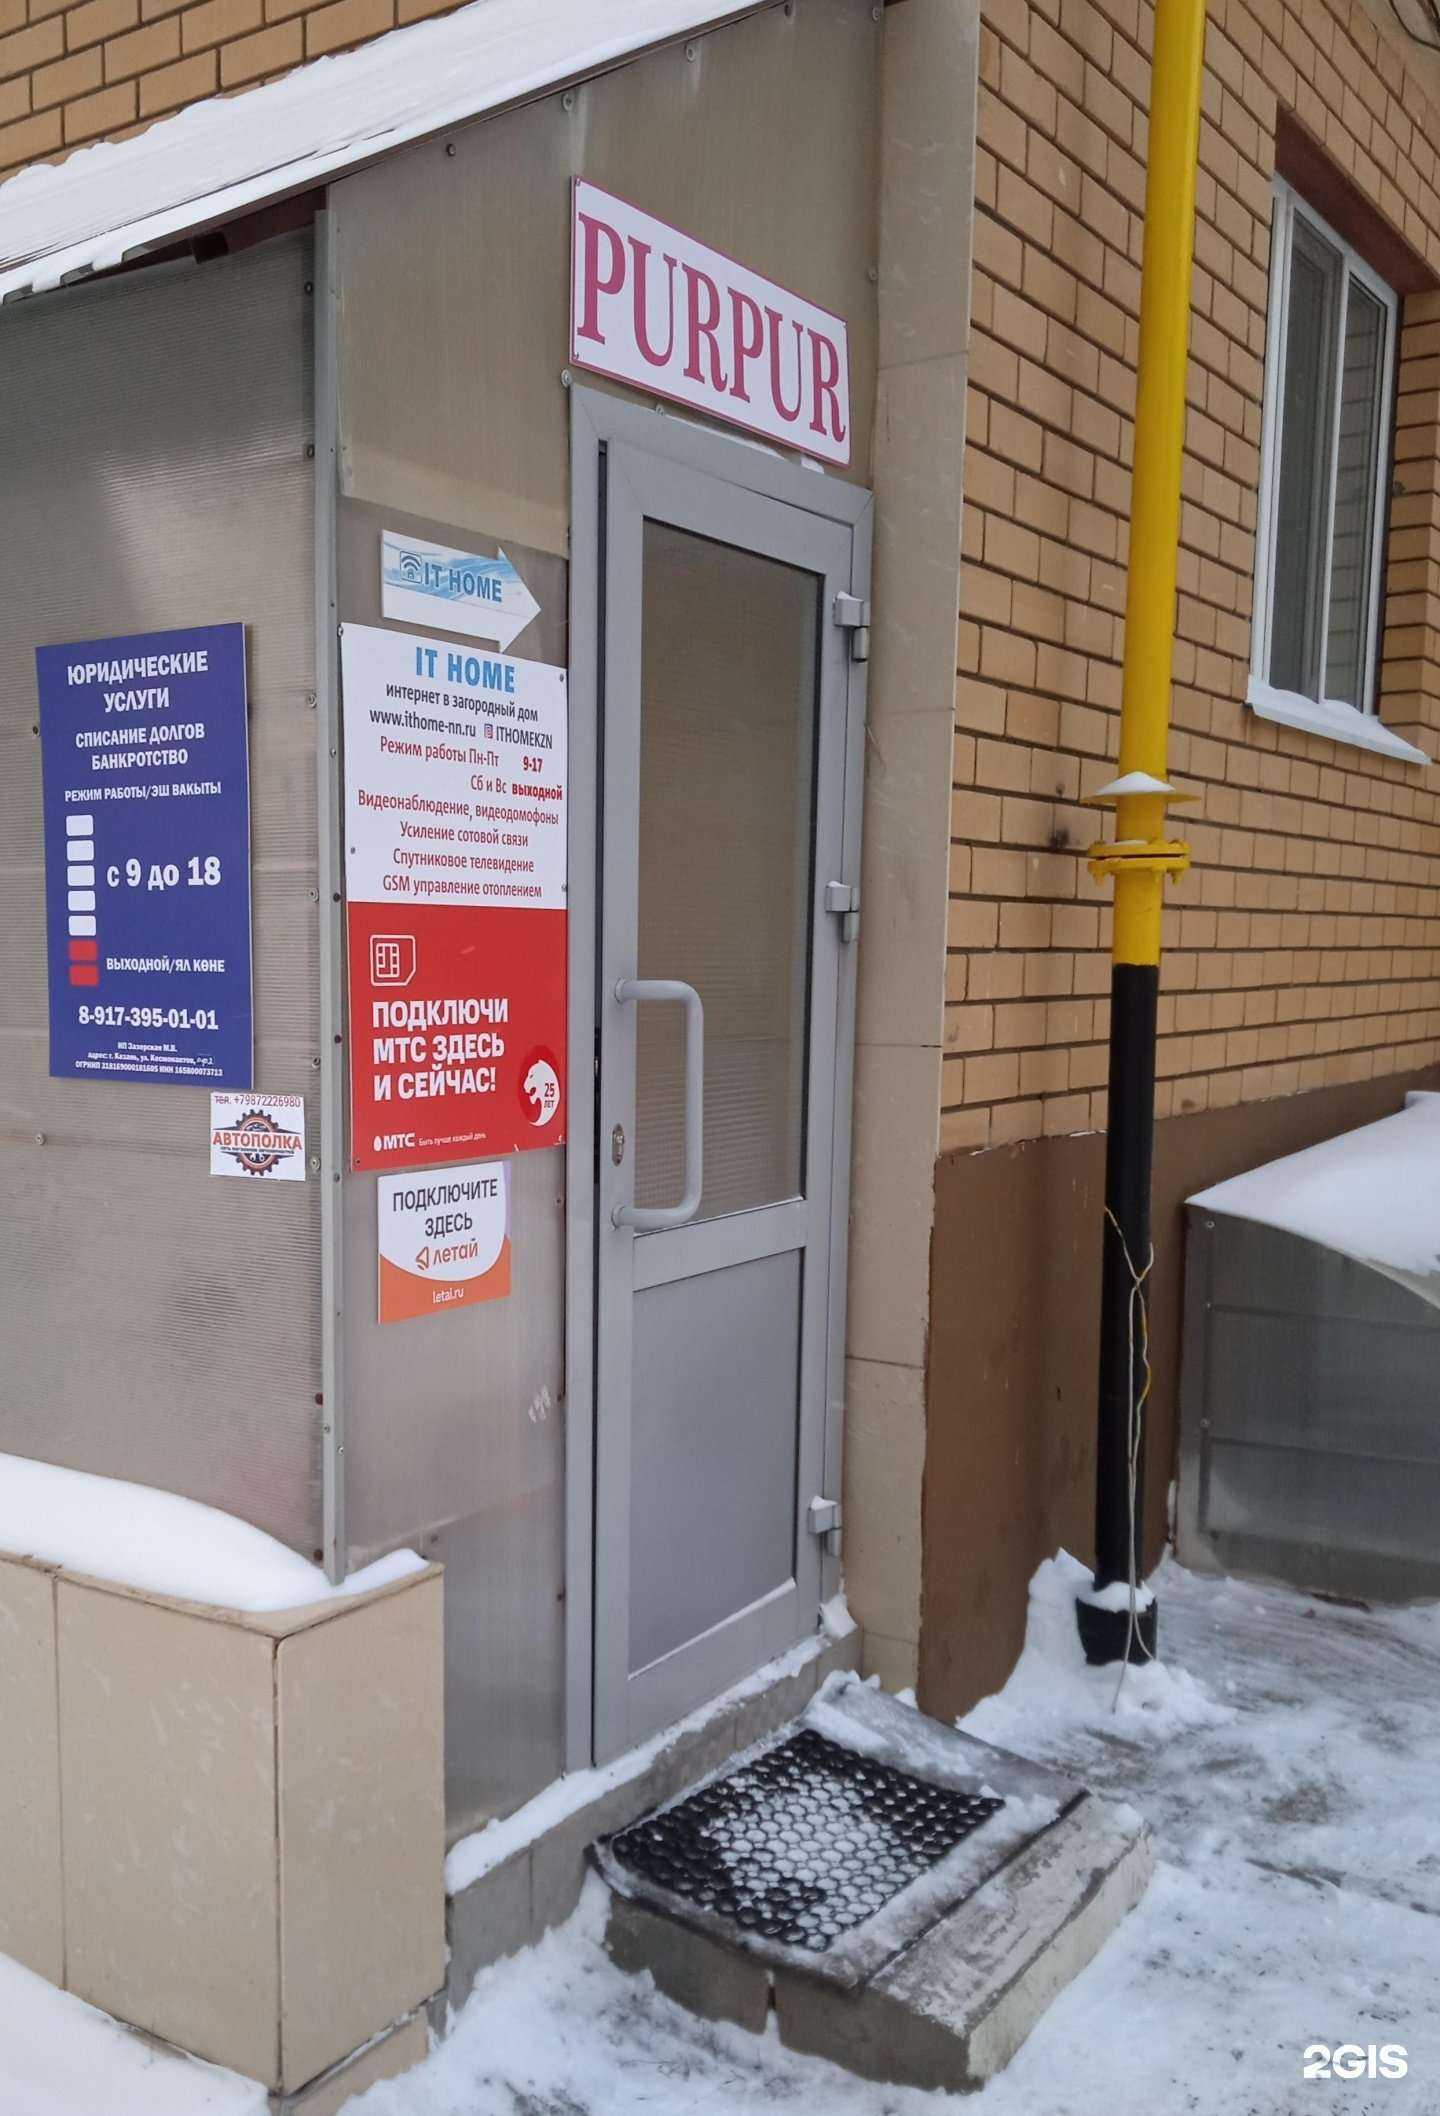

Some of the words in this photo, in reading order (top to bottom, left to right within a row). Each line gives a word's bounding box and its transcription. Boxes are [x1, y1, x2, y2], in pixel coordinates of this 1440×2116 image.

[577, 211, 846, 443] PURPUR
[424, 562, 442, 587] IT
[449, 568, 502, 602] HOME
[67, 650, 209, 686] ЮРИДИЧЕСКИЕ
[416, 646, 438, 678] IT
[447, 653, 515, 693] HOME
[103, 687, 170, 713] УСЛУГИ
[386, 683, 440, 705] интернет
[443, 693, 450, 706] в
[452, 695, 515, 718] загородный
[517, 707, 538, 722] дом
[75, 728, 147, 749] СПИСАНИЕ
[149, 723, 205, 745] ДОЛГОВ
[369, 709, 476, 737] www.ithome-nn.ru
[496, 725, 552, 749] ITHOMEKZN
[91, 749, 188, 770] БАНКРОТСТВО
[380, 735, 422, 757] Режим
[425, 743, 466, 762] работы
[469, 747, 499, 767] Пн-Пт
[523, 755, 543, 773] 9-17
[64, 787, 102, 803] РЕЖИМ
[103, 784, 170, 801] РАБОТЫ/ЭШ
[172, 781, 222, 798] ВАКЫТЫ
[470, 774, 484, 791] Сб
[486, 780, 493, 792] и
[496, 778, 507, 794] Вс
[511, 783, 563, 801] выходной
[358, 788, 473, 821] Видеонаблюдение,
[475, 804, 559, 827] видеодомофоны
[400, 820, 455, 841] Усиление
[457, 828, 499, 845] сотовой
[501, 833, 528, 847] связи
[124, 858, 142, 888] 9
[147, 862, 180, 892] до
[187, 856, 222, 888] 18
[393, 847, 468, 869] Спутниковое
[470, 856, 534, 874] телевидение
[383, 874, 411, 892] GSM
[413, 878, 481, 897] управление
[482, 882, 542, 898] отоплением
[106, 955, 191, 974] ВЫХОДНОЙ/ЯЛ
[193, 957, 225, 974] КӨНЕ
[78, 1006, 219, 1031] 8-917-395-01-01
[372, 998, 509, 1032] ПОДКЛЮЧИ
[373, 1037, 426, 1065] МТС
[432, 1032, 505, 1064] ЗДЕСЬ
[374, 1074, 391, 1101] И
[398, 1063, 496, 1098] СЕЙЧАС!
[544, 1082, 555, 1098] 25
[233, 1094, 301, 1108] +79872226980
[213, 1131, 302, 1150] АВТОПОЛКА
[384, 1133, 415, 1150] МТС
[392, 1178, 499, 1213] ПОДКЛЮЧИТЕ
[424, 1215, 473, 1239] ЗДЕСЬ
[433, 1238, 478, 1265] летай
